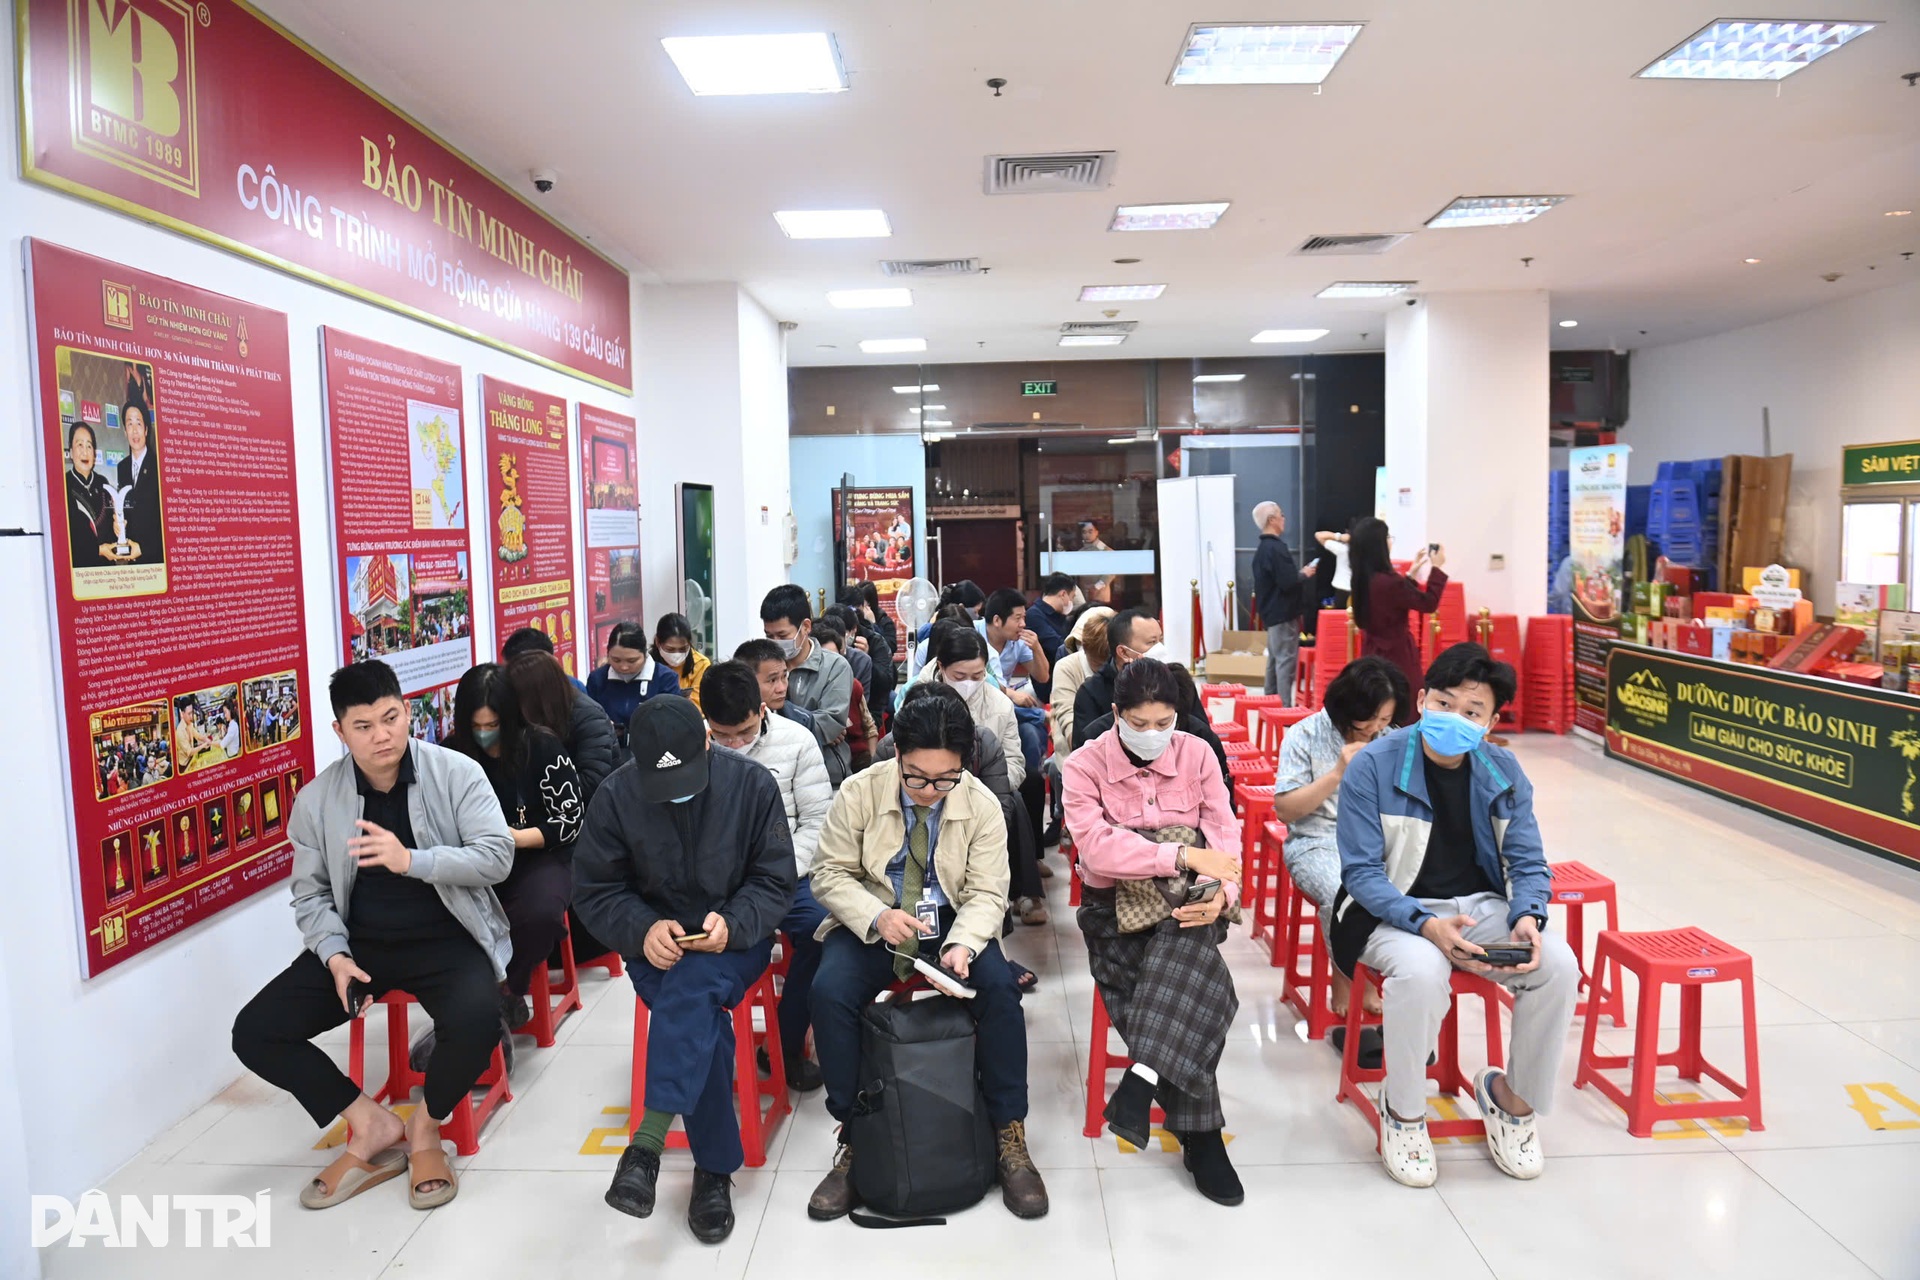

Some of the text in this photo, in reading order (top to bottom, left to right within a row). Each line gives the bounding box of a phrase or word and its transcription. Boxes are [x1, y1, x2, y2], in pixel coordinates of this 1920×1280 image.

[91, 109, 182, 169] BTMC 1989
[361, 134, 584, 304] BẢO TÍN MINH CHÂU
[237, 163, 626, 370] CÔNG TRÌNH MỞ RỘNG CỬA HÀNG 139 CẦU GIẤY
[139, 293, 232, 329] BẢO TÍN MINH CHÂU
[54, 328, 74, 343] BẢO
[76, 332, 92, 346] TÍN
[94, 335, 118, 351] MINH
[120, 340, 143, 356] CHÂU
[145, 345, 162, 359] HƠN
[164, 349, 172, 361] 36
[173, 350, 190, 365] NĂM
[191, 354, 209, 369] HÌNH
[211, 358, 234, 373] THÀNH
[235, 362, 245, 375] VÀ
[246, 364, 261, 378] PHÁT
[262, 367, 282, 382] TRIỂN
[498, 390, 534, 412] VÀNG RỒNG
[1024, 382, 1052, 394] EXIT
[490, 409, 543, 435] THĂNG LONG
[1861, 453, 1920, 473] SÂM VIỆT
[1676, 681, 1878, 749] DƯỠNG DƯỢC BẢO SINH
[656, 759, 682, 768] adidas
[1693, 719, 1846, 779] LÀM GIÀU CHO SỨC KHỎE
